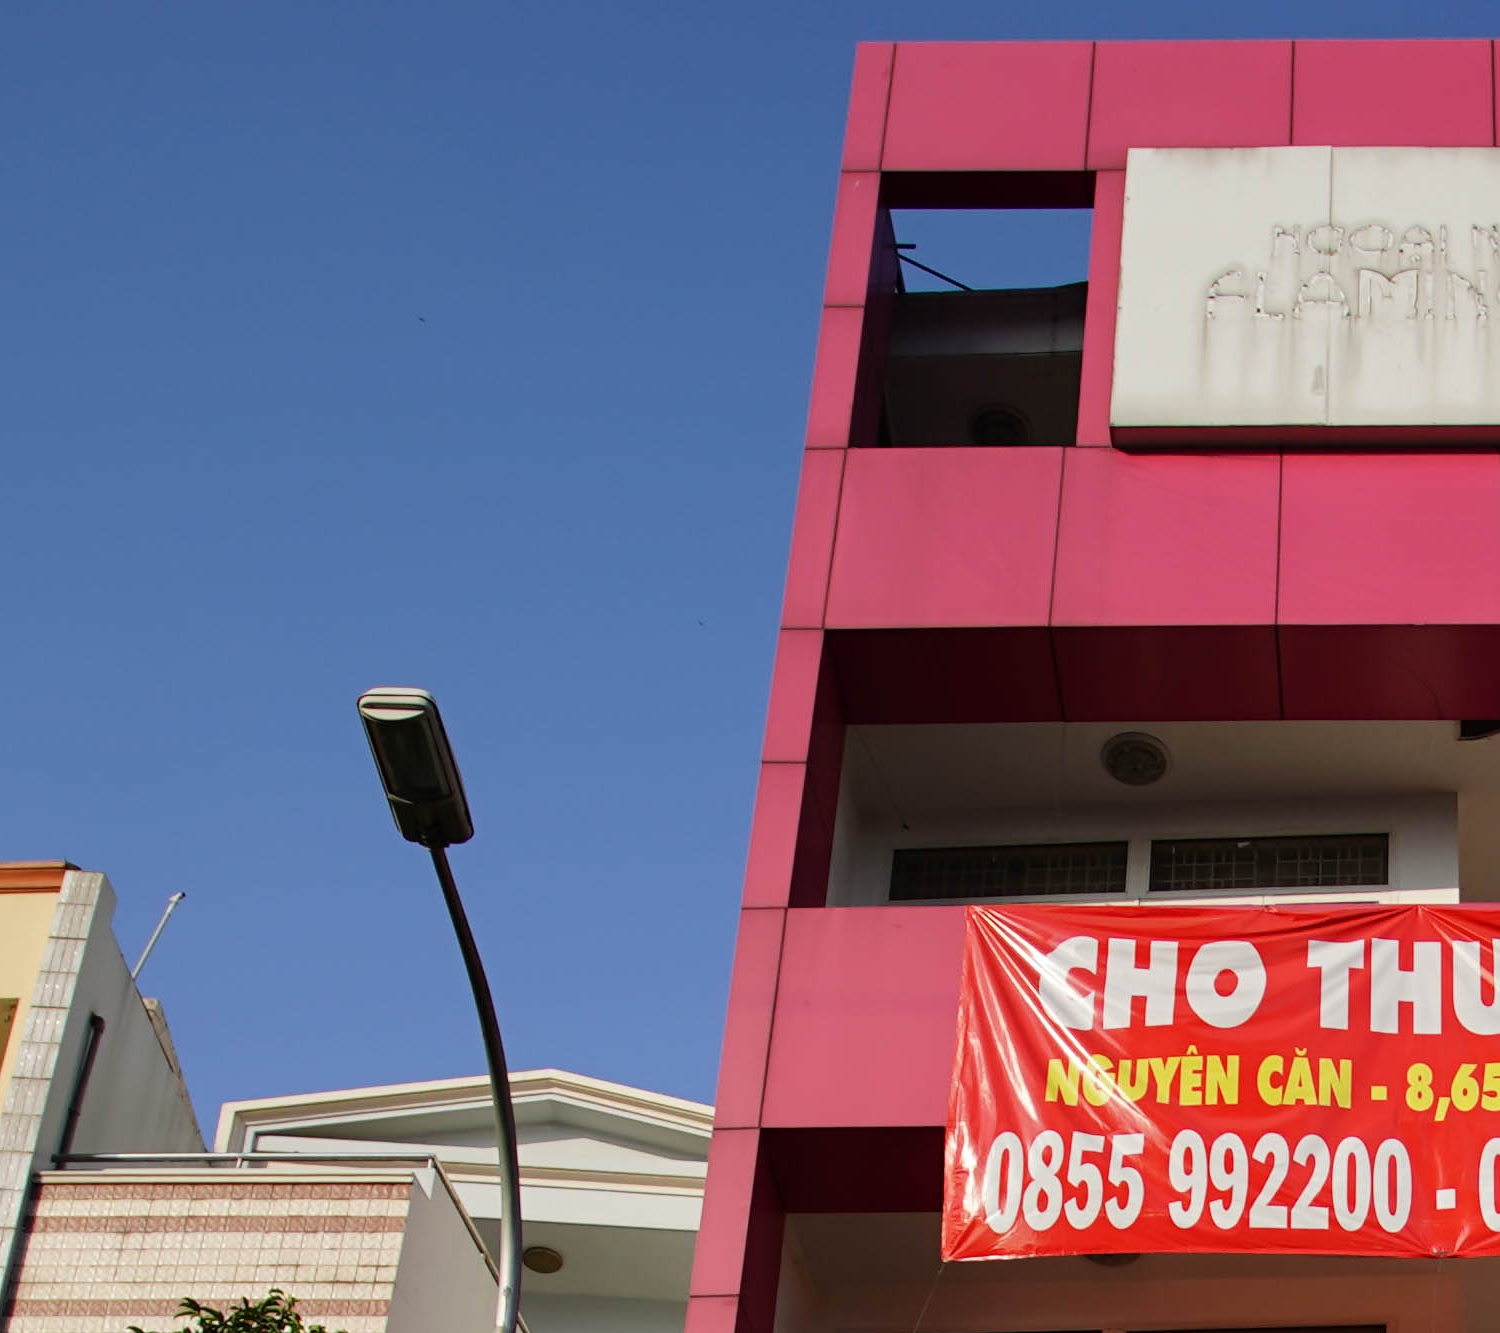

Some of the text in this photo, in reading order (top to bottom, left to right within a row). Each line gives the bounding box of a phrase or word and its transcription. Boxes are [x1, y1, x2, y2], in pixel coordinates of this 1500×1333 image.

[1038, 935, 1268, 1036] CHO
[1043, 1041, 1242, 1108] NGUYÊN
[1256, 1047, 1353, 1108] CĂN
[985, 1129, 1146, 1235] 0855
[1167, 1130, 1414, 1235] 992200
